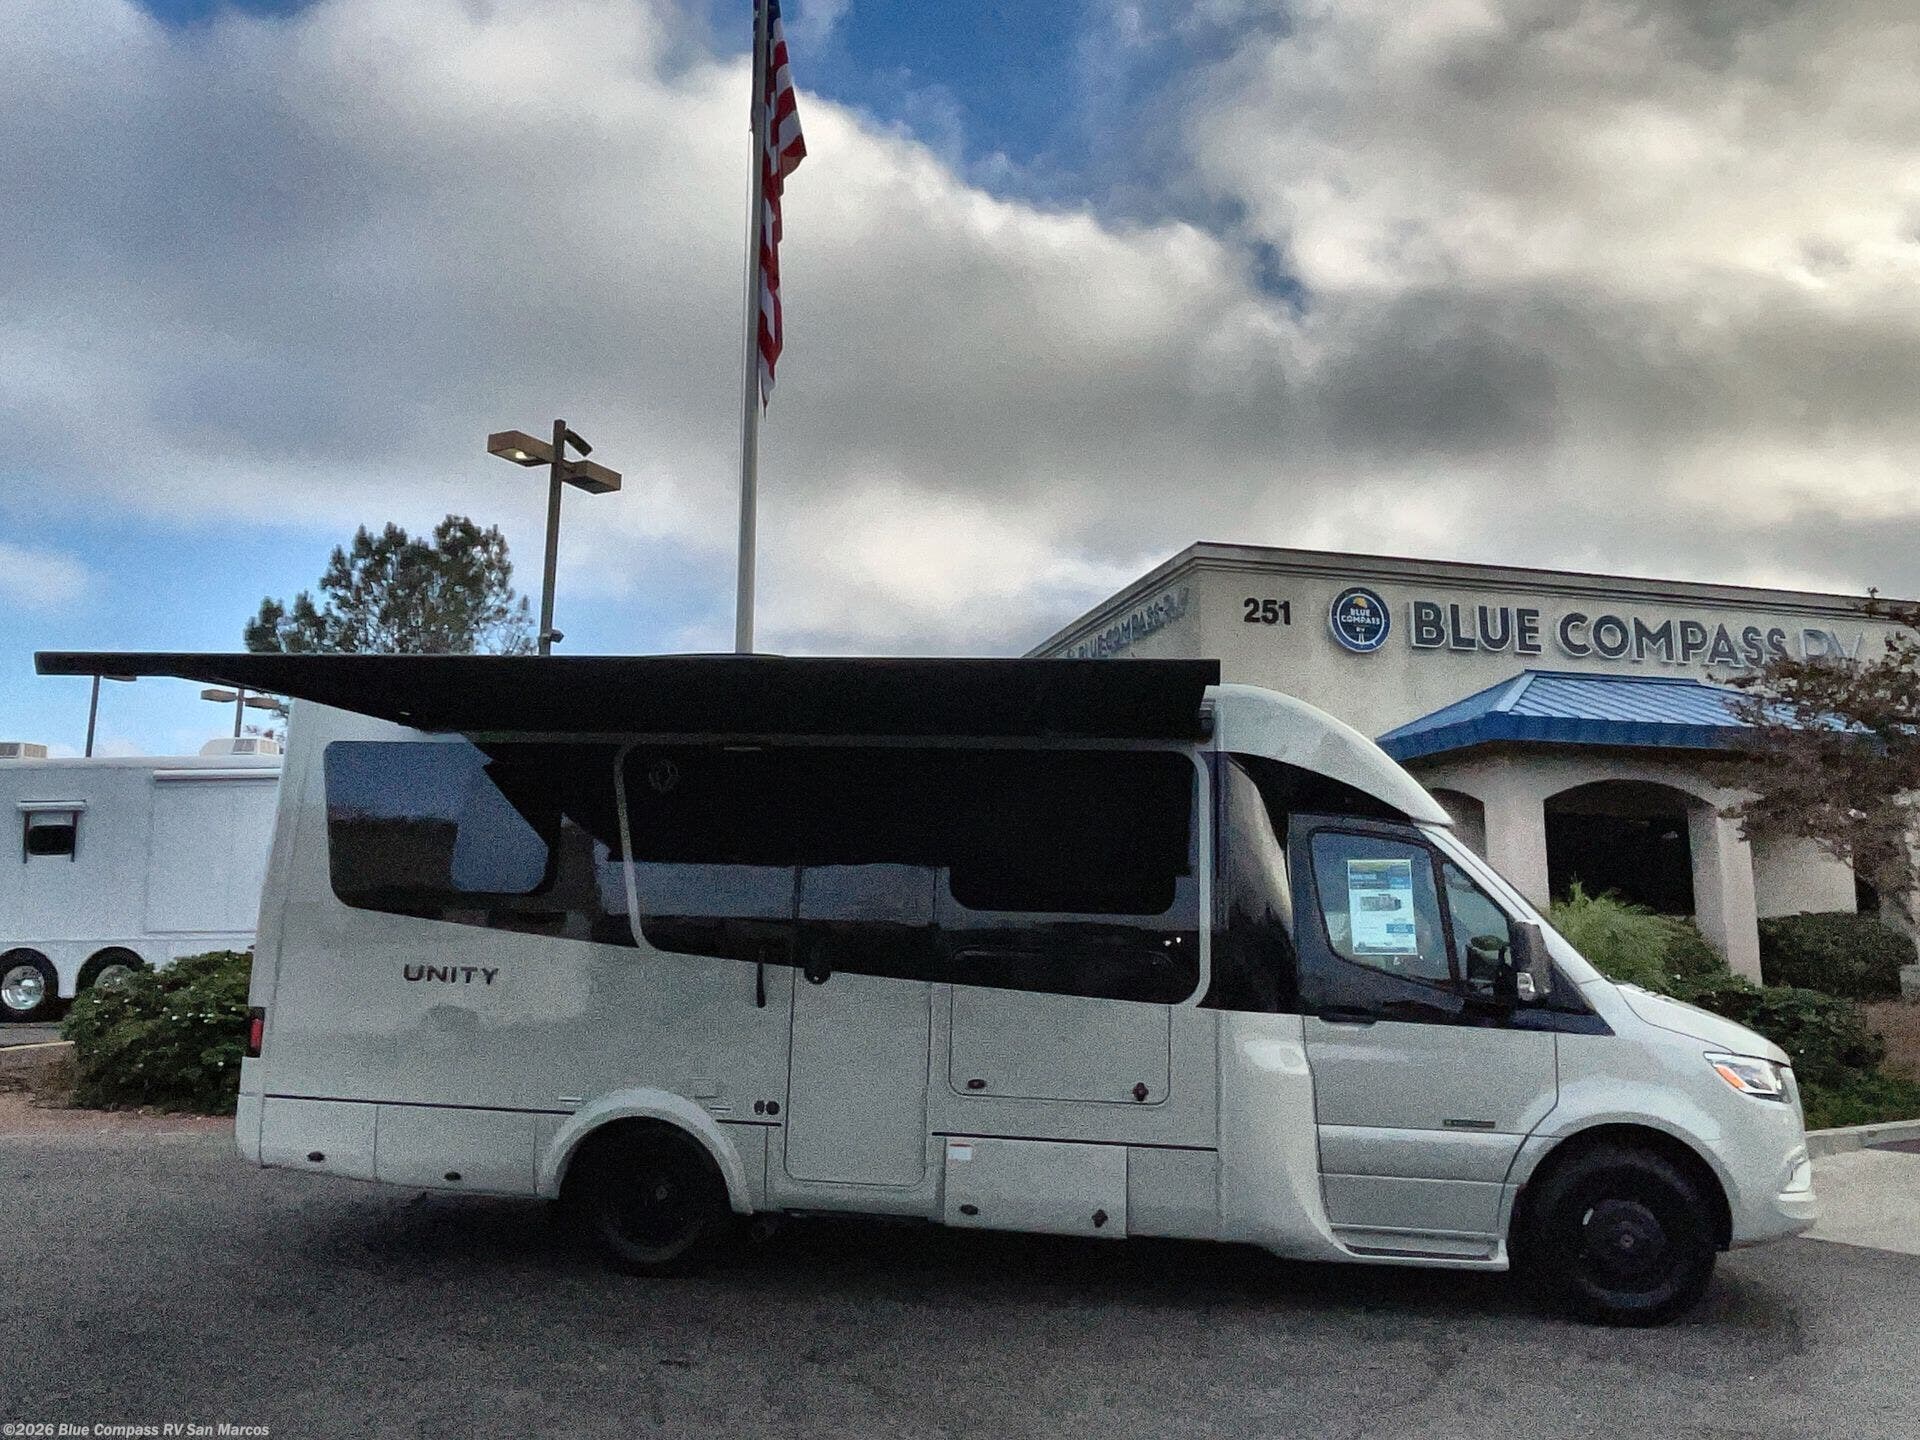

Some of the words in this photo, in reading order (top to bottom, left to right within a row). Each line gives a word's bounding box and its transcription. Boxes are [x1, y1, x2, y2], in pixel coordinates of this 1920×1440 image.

[1243, 597, 1291, 626] 251
[1340, 614, 1381, 625] COMPASS
[1350, 607, 1371, 617] BLUE
[1409, 600, 1542, 655] BLUE
[1557, 612, 1790, 668] COMPASS
[403, 963, 499, 985] UNITY
